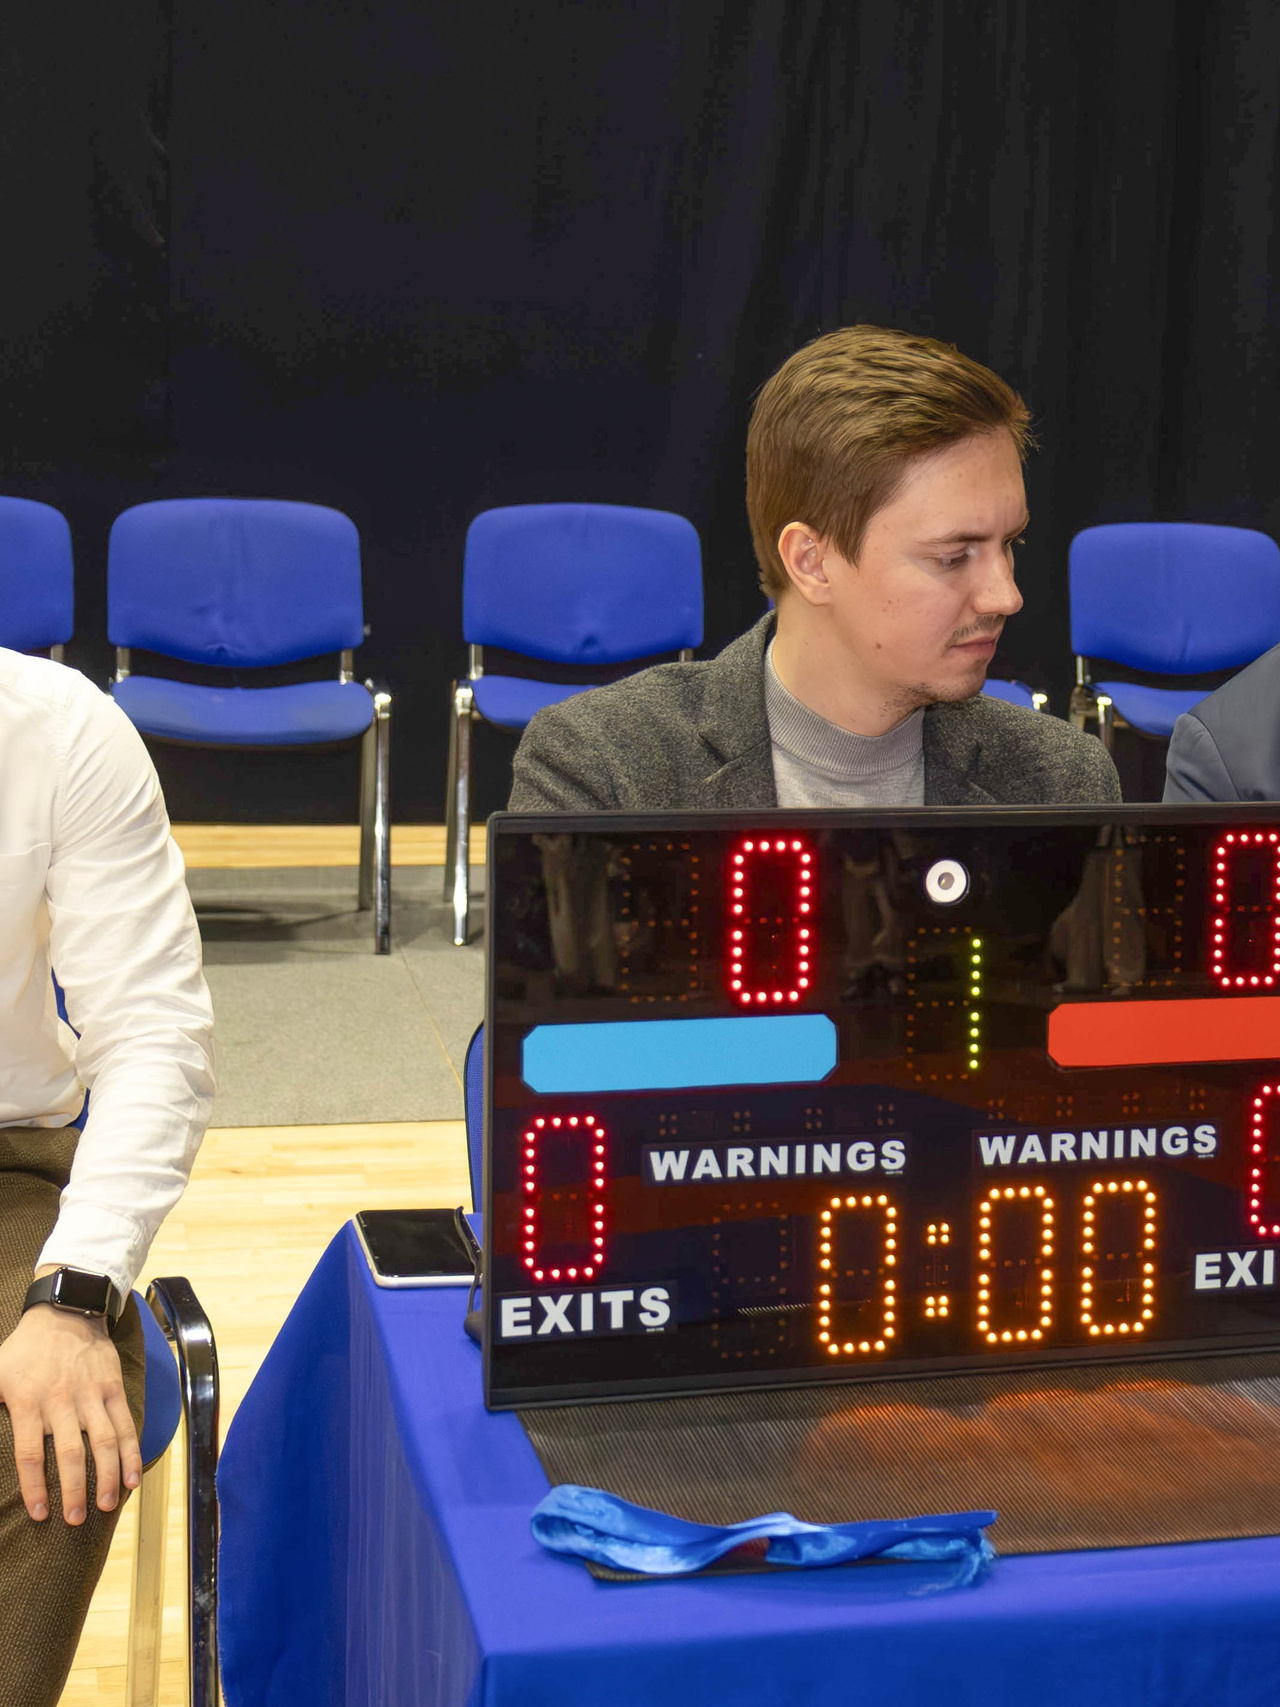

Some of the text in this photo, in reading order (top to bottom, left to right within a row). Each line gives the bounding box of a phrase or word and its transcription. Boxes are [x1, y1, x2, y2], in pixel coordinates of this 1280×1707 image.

[728, 838, 813, 1005] 0
[522, 1115, 606, 1282] 0
[649, 1140, 906, 1182] WARNINGS
[979, 1125, 1217, 1166] WARNINGS
[501, 1287, 671, 1338] EXITS
[818, 1179, 1158, 1356] 0:00
